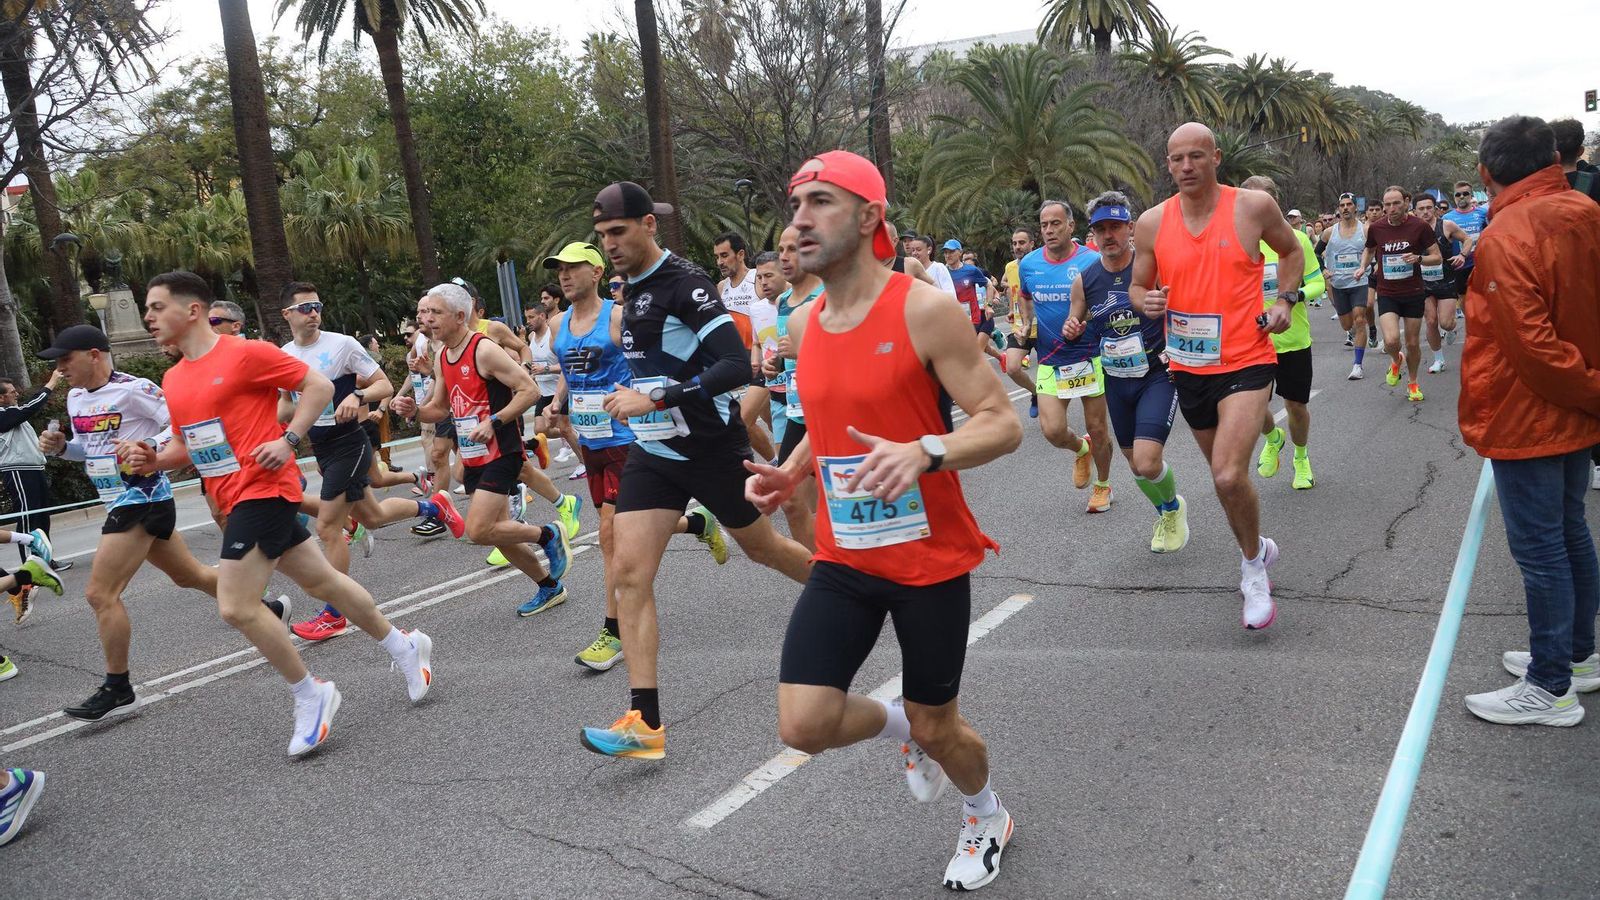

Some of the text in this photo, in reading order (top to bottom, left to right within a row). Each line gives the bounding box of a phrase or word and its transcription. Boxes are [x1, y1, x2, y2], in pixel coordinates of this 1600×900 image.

[1384, 241, 1410, 252] WILD
[1391, 265, 1407, 273] 442
[1179, 338, 1205, 353] 214
[1068, 377, 1087, 389] 927
[578, 414, 598, 427] 380
[199, 449, 221, 464] 616
[851, 500, 898, 524] 475
